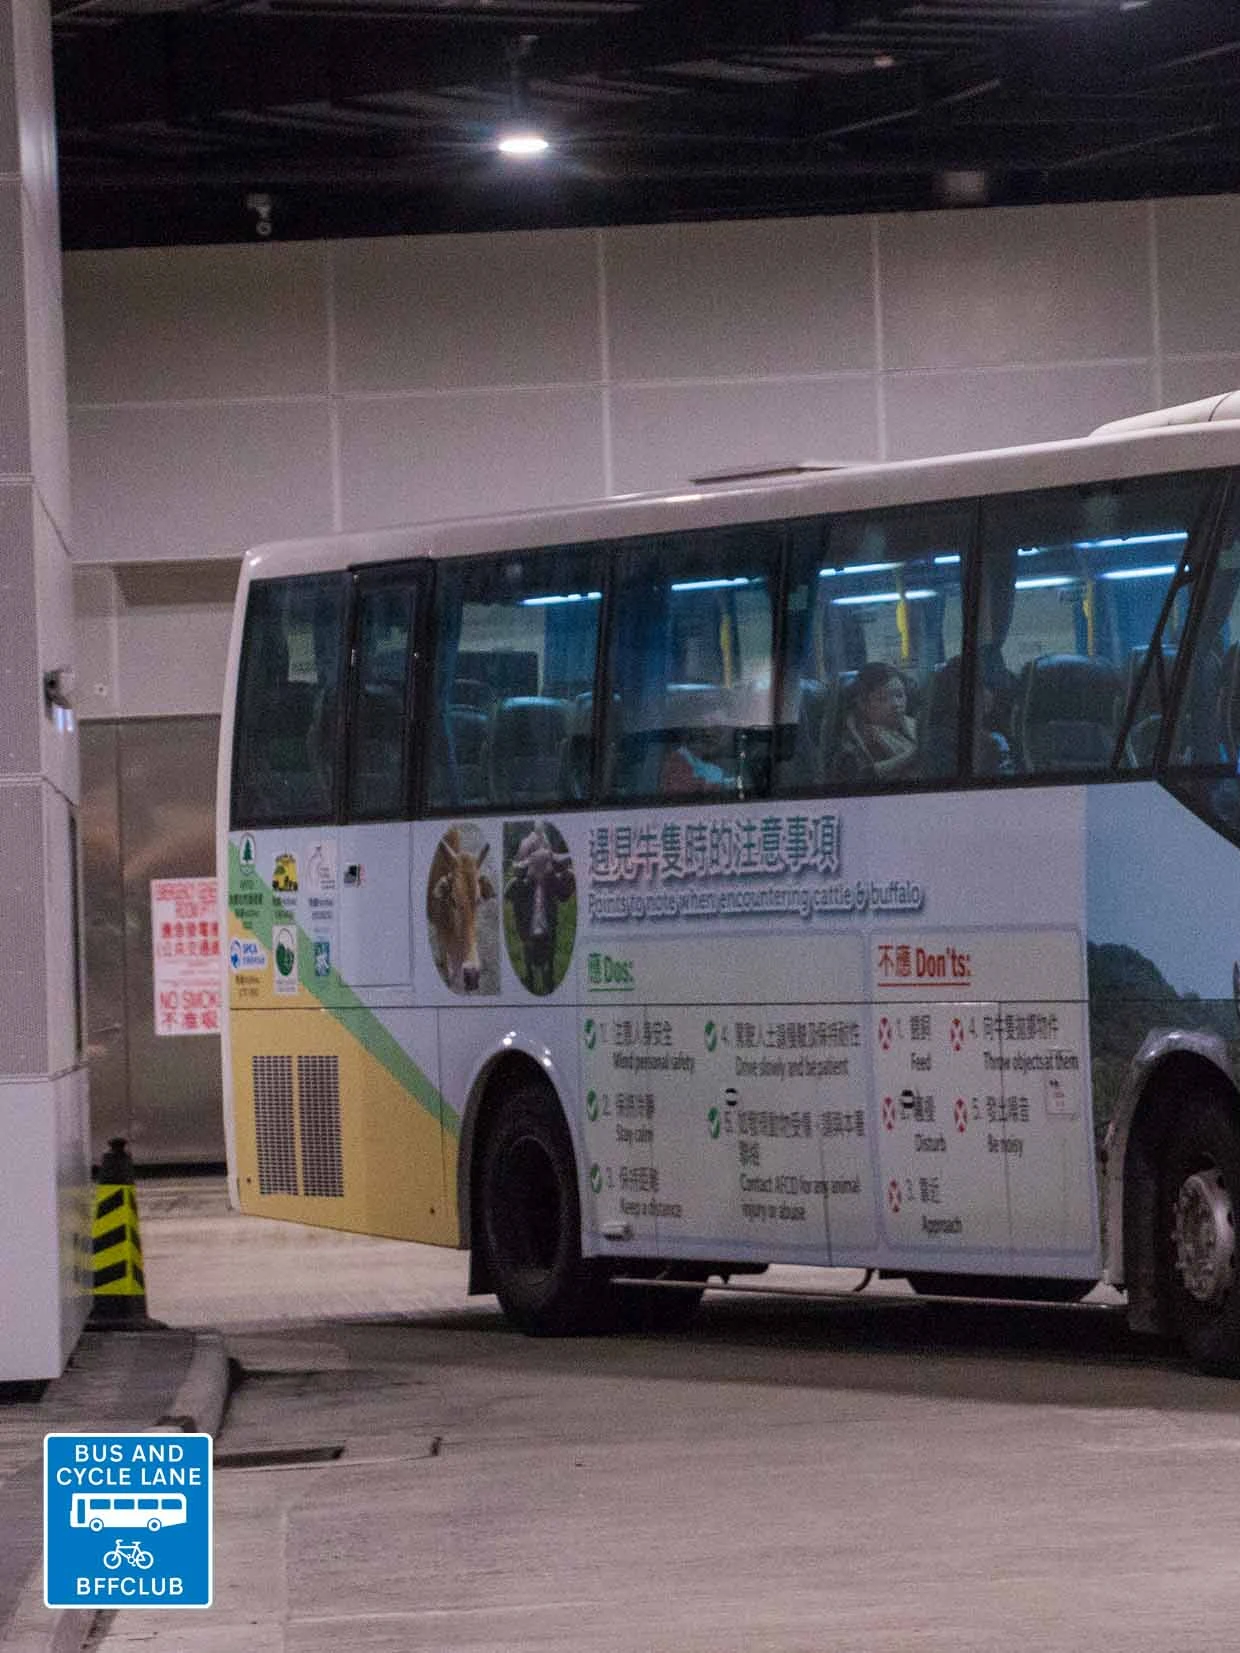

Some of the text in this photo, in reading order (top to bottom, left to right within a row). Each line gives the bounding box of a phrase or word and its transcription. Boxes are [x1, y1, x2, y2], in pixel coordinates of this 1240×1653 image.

[588, 814, 840, 878] 遇見牛隻時的注意事項
[680, 890, 716, 912] when
[719, 887, 810, 917] encountering
[814, 882, 851, 906] cattle
[855, 880, 867, 905] &
[870, 879, 921, 906] buffalo
[604, 956, 634, 983] Dos:
[878, 944, 971, 978] 不應 Don'ts:
[183, 990, 219, 1010] SMOK
[911, 1051, 932, 1072] Feed
